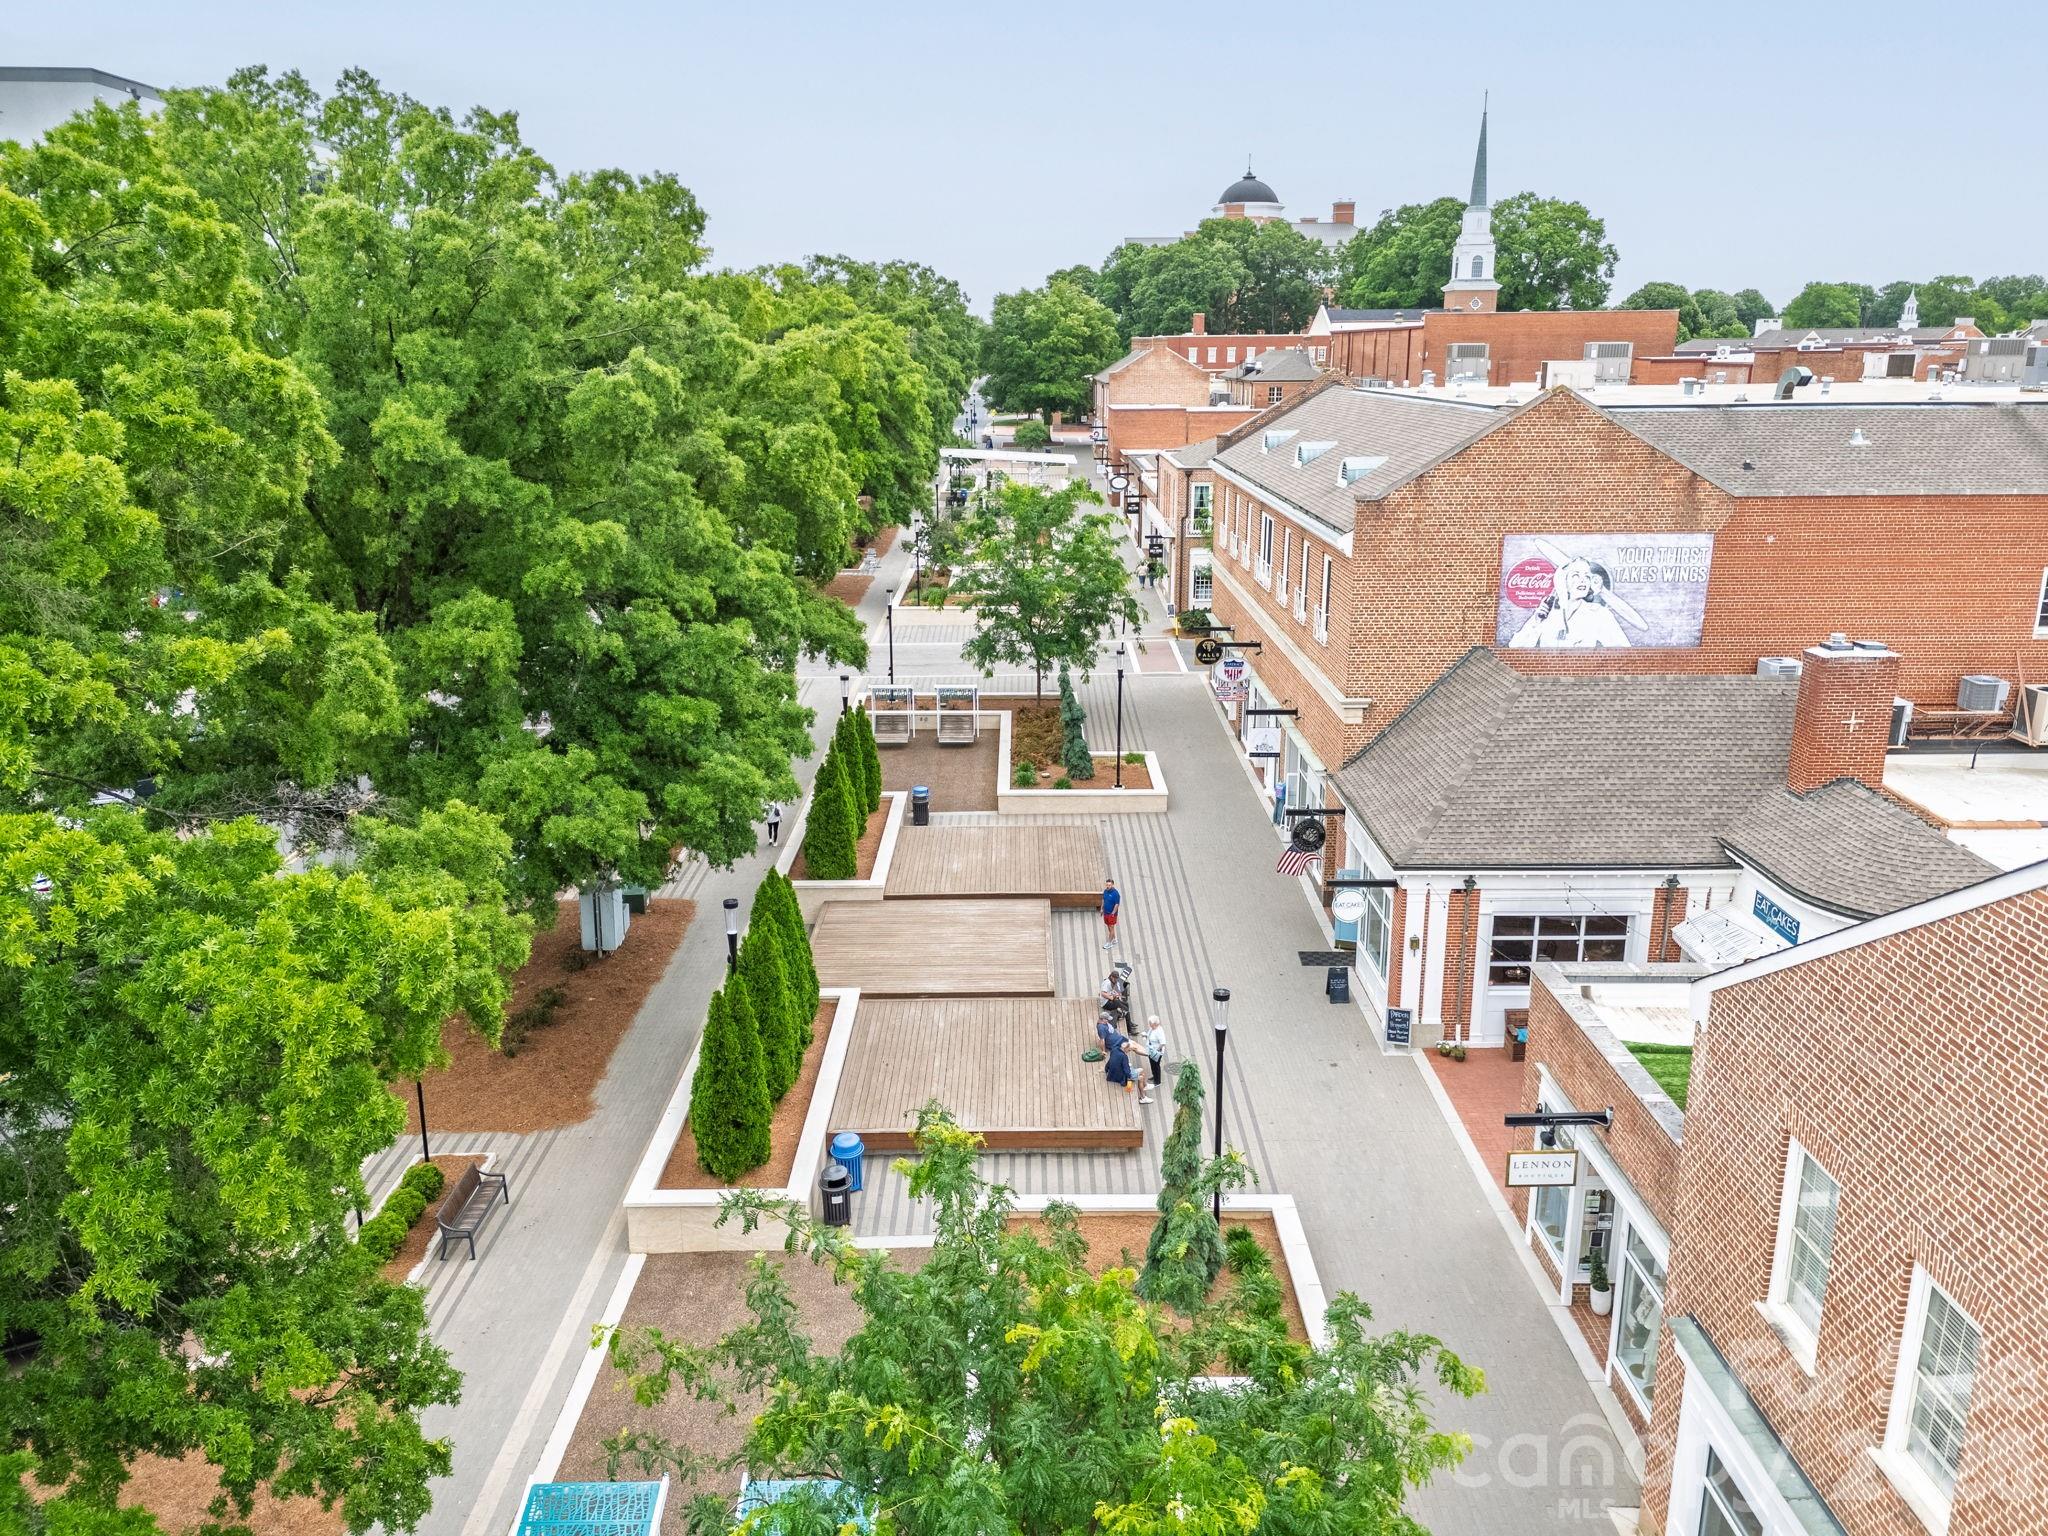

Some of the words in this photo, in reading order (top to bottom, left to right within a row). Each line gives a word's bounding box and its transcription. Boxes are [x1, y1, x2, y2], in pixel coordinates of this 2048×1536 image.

[1617, 547, 1654, 564] YOUR
[1658, 547, 1709, 564] THIRST
[1614, 566, 1658, 583] TAKES
[1662, 566, 1708, 583] WINGS
[1756, 894, 1771, 915] EAT
[1770, 906, 1798, 936] CAKES
[1513, 1160, 1573, 1169] LENNON
